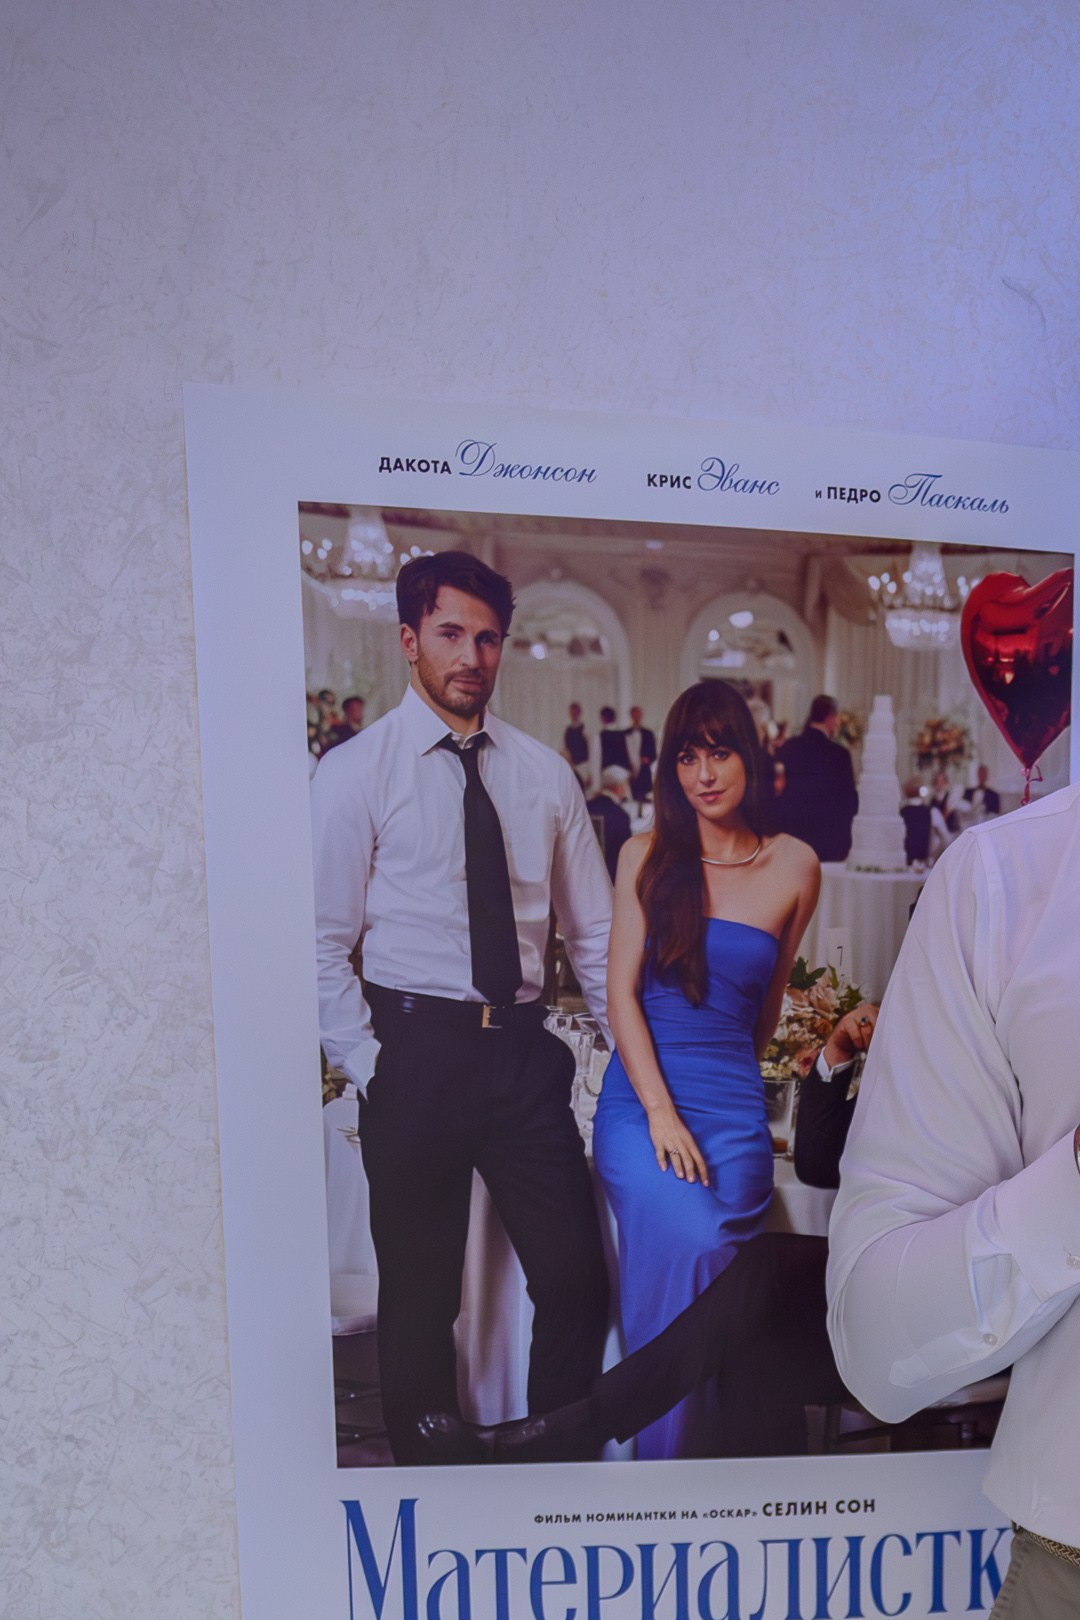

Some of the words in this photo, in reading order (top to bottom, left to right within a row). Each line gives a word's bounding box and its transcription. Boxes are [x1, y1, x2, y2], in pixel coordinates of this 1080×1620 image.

[379, 456, 452, 475] ДАКОТА
[455, 439, 598, 483] Джонсон
[647, 473, 692, 490] КРИС
[697, 457, 781, 496] Эванс
[827, 486, 881, 504] ПЕДРО
[888, 472, 1010, 514] Паскаль
[534, 1513, 582, 1525] ФИЛЬМ
[586, 1510, 677, 1523] НОМИНАНТКИ
[681, 1510, 698, 1520] НА
[702, 1508, 758, 1520] «ОСКАР»
[762, 1500, 828, 1517] СЕЛИН
[835, 1499, 876, 1514] СОН
